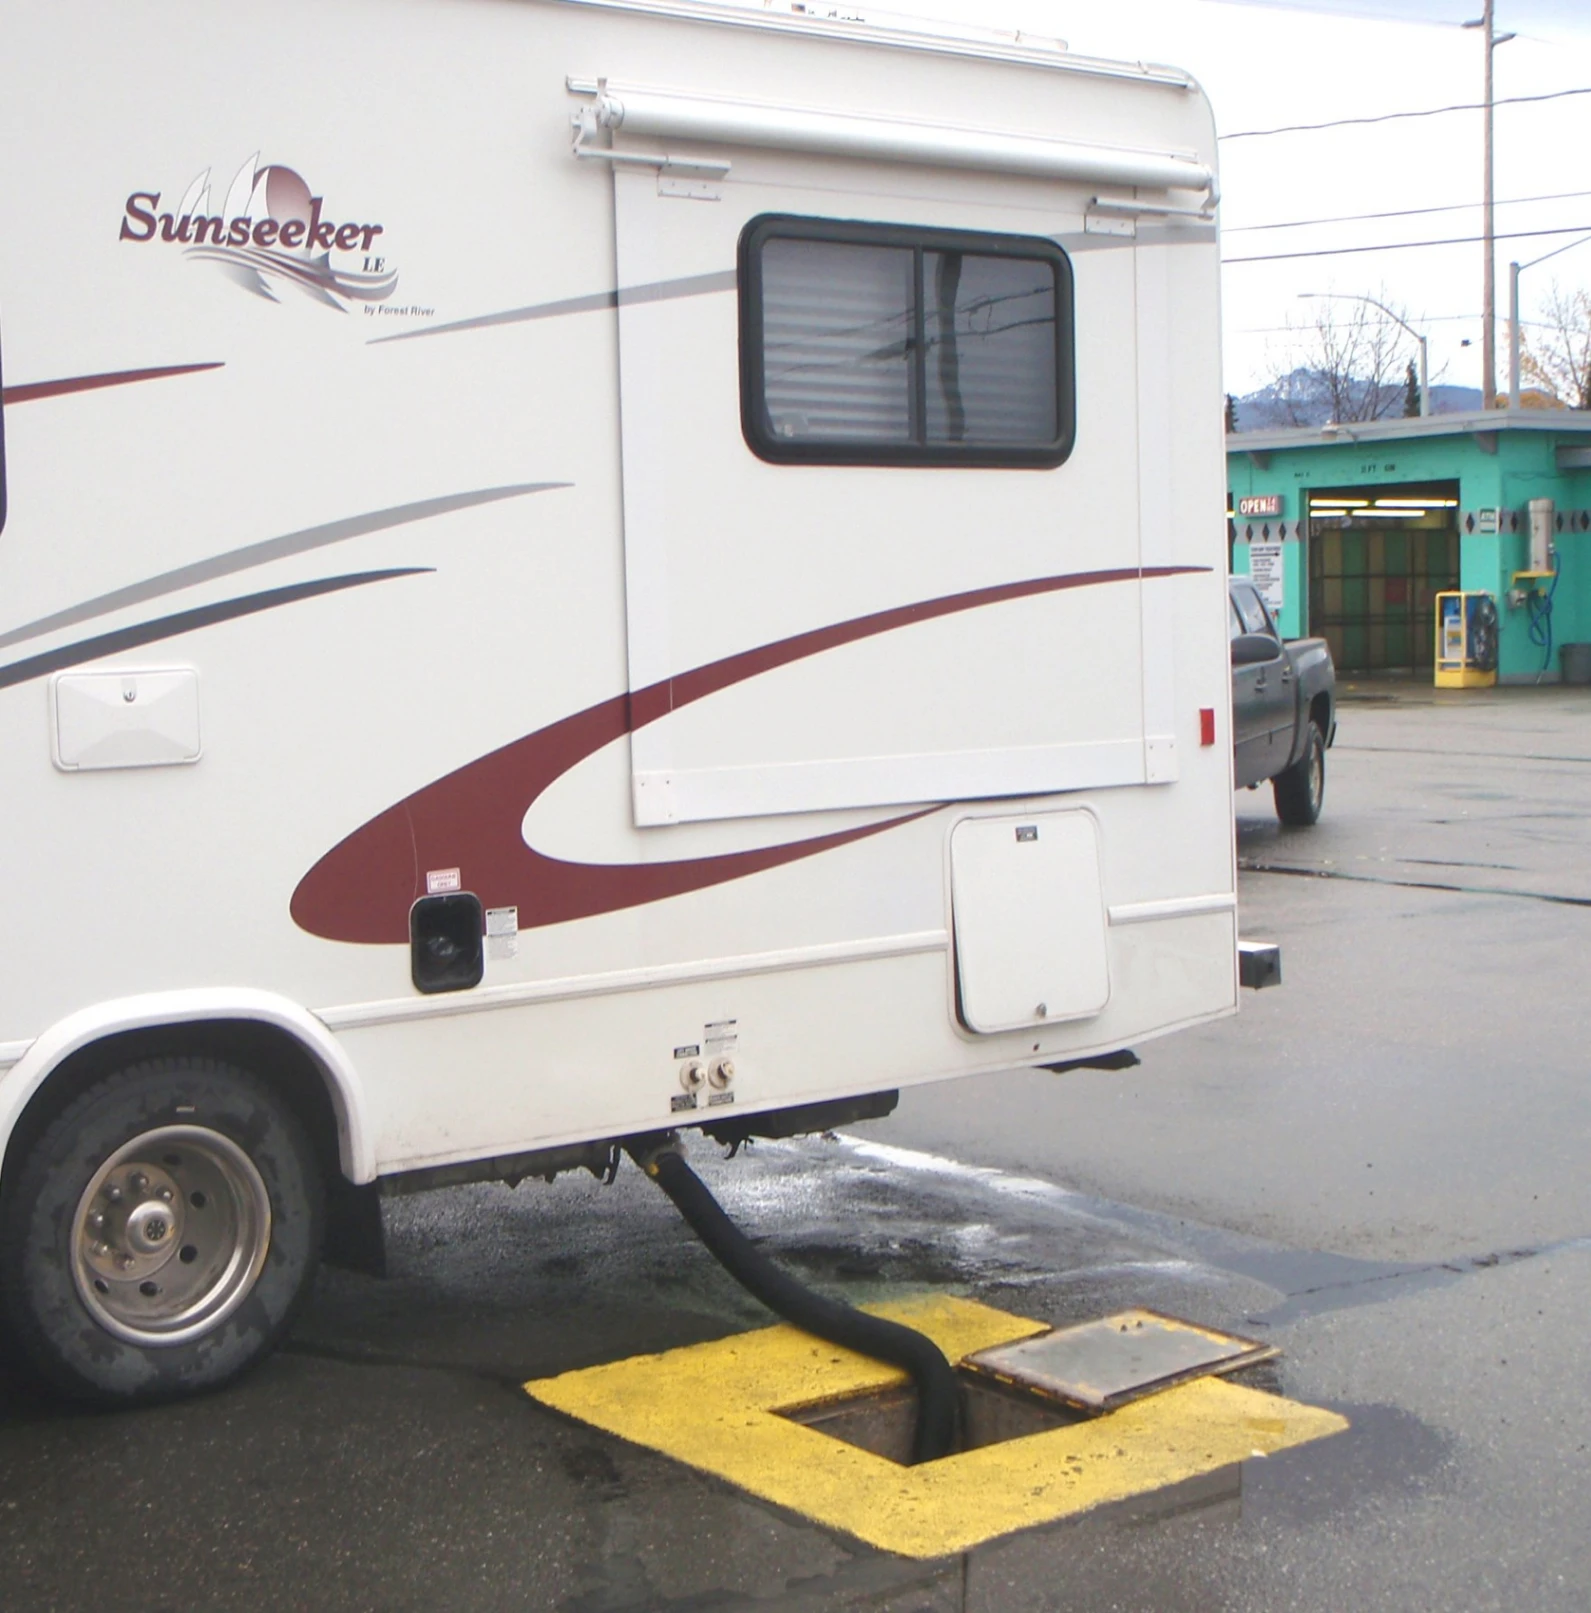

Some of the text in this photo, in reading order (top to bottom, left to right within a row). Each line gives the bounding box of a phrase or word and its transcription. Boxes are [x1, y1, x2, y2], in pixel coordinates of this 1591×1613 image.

[119, 191, 383, 251] Sunseeker
[362, 257, 385, 273] LE
[364, 305, 435, 316] by Forest River
[1240, 499, 1267, 514] OPEN
